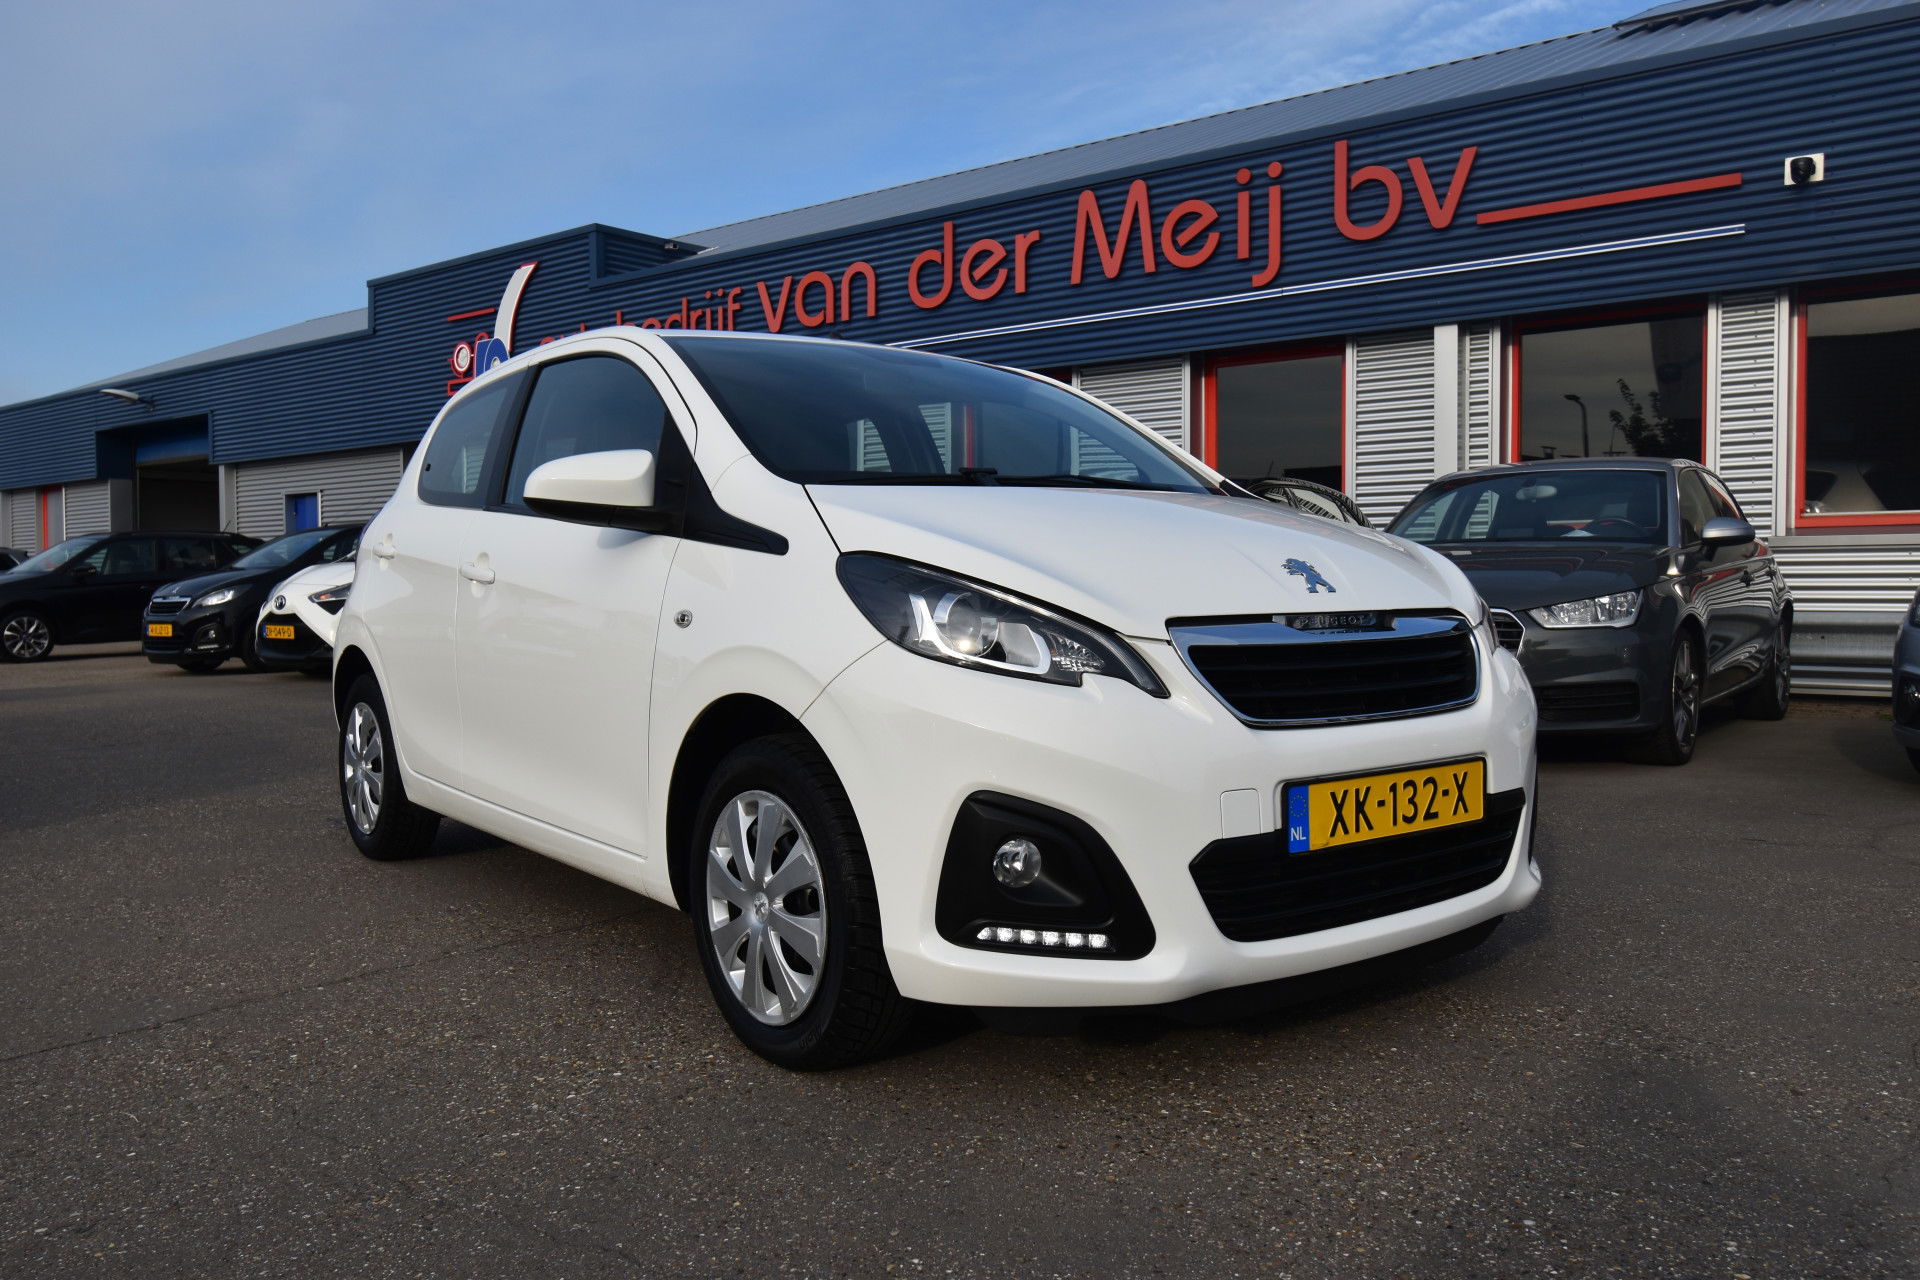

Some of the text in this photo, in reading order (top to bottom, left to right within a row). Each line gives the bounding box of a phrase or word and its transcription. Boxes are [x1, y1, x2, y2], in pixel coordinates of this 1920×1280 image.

[758, 262, 876, 332] van
[909, 221, 1041, 309] der
[1071, 161, 1283, 287] Meij
[1334, 140, 1477, 242] bv
[1290, 826, 1307, 842] NL
[1329, 771, 1469, 838] XK-132-X
